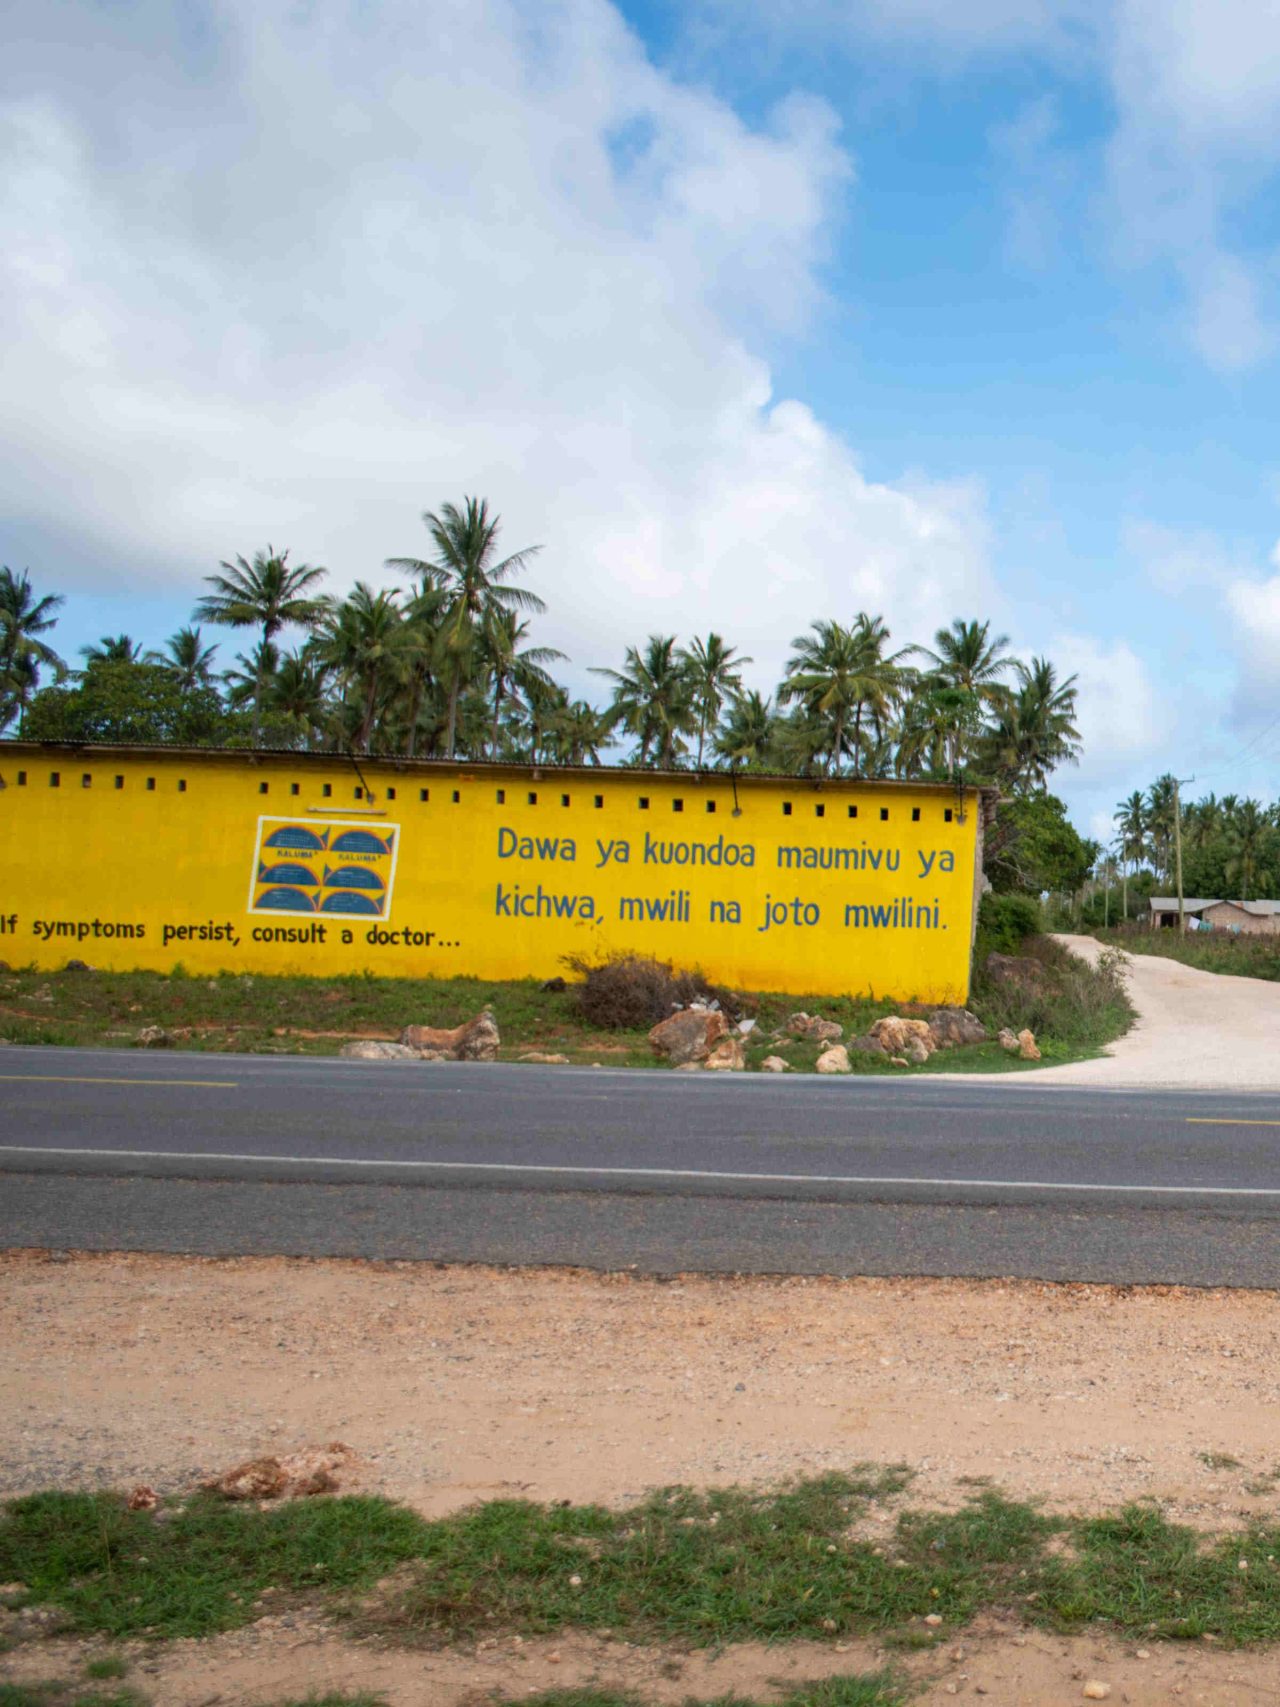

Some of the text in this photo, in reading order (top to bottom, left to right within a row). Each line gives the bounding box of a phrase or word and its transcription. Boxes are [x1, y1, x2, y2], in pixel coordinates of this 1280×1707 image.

[497, 826, 955, 879] Dawa ya kuondoa maumivu ya
[0, 914, 461, 948] If symptoms persist, consult a doctor...
[495, 883, 949, 932] kichwa, mwili na joto mwilini.
